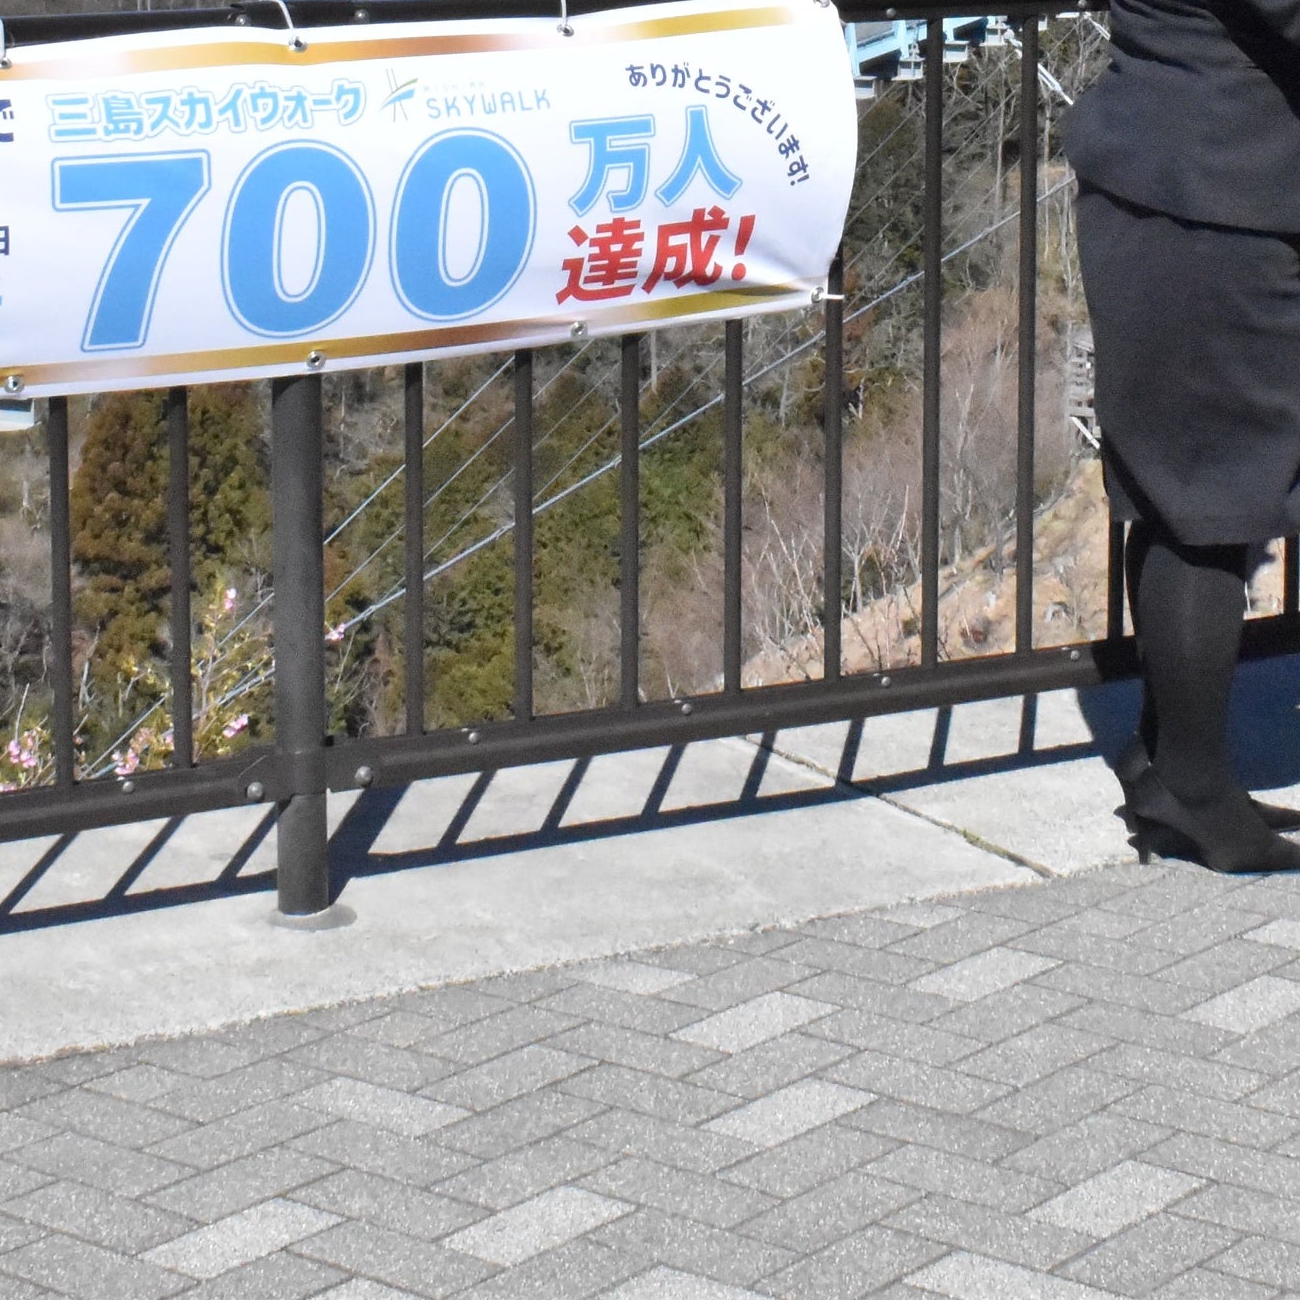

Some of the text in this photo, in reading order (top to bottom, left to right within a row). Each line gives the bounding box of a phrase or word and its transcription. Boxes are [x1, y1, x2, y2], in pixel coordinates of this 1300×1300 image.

[46, 78, 367, 142] 三島スカイウォーク
[426, 89, 551, 119] SKYWALK
[626, 62, 810, 186] ありがとうございます!
[556, 205, 756, 305] 達成!
